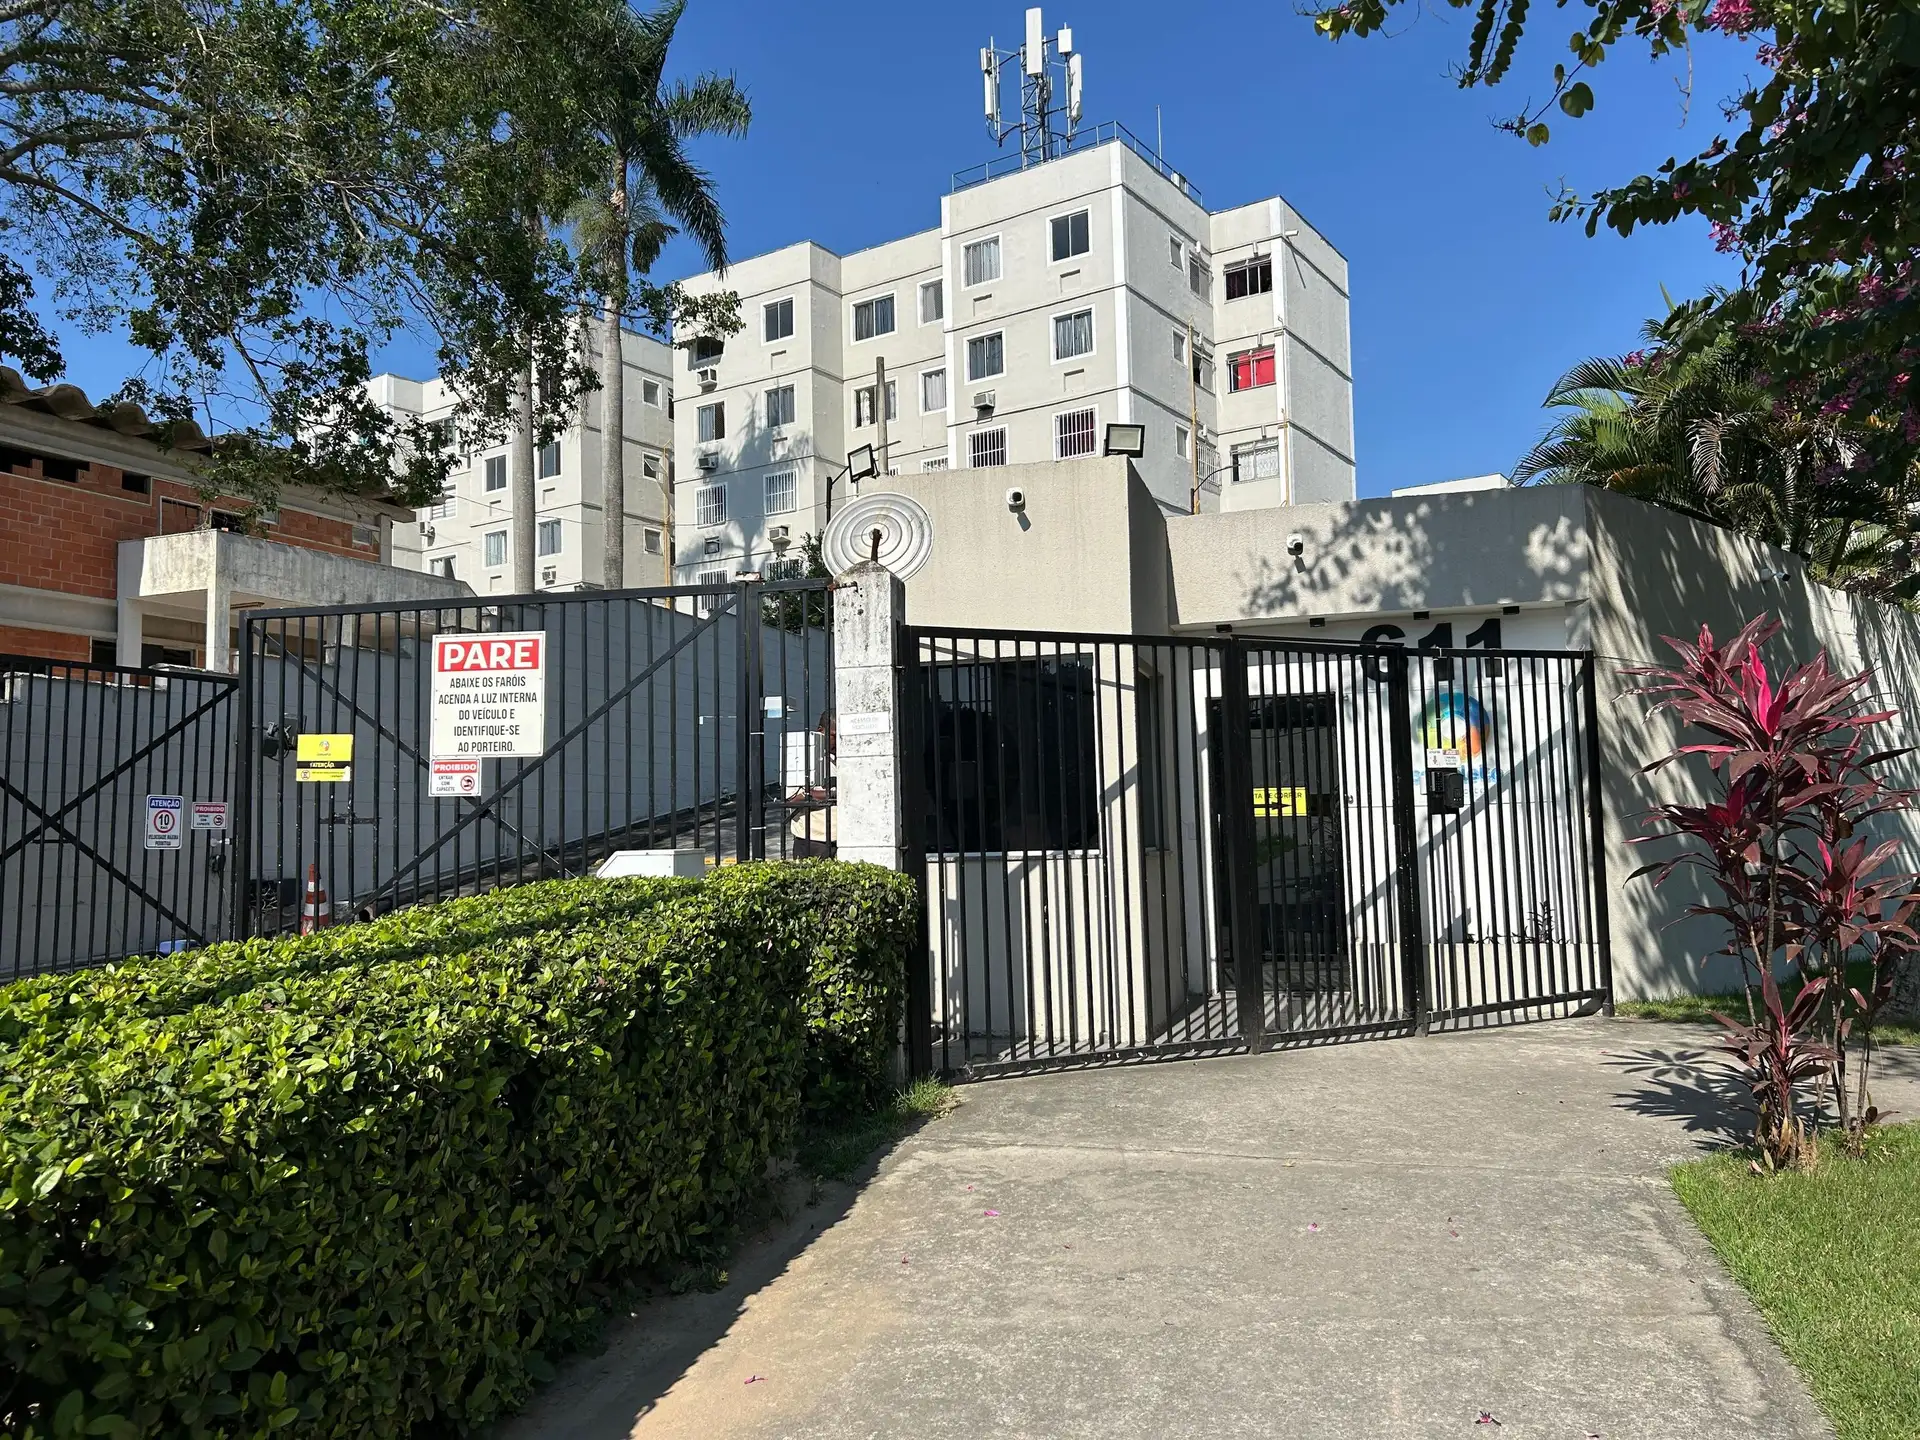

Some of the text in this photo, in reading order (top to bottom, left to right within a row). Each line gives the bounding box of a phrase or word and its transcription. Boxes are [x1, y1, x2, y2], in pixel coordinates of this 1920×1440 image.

[443, 641, 534, 671] PARE
[1361, 618, 1502, 683] 611
[450, 674, 526, 689] ABAIXE OS FARÓIS
[438, 691, 538, 705] ACENDA A LUZ INTERNA
[458, 707, 516, 721] DO VEÍCULO E
[453, 724, 521, 737] IDENTIFIQUE-SE
[457, 740, 516, 753] AO PORTEIRO.
[435, 763, 477, 771] PROIBIDO
[150, 799, 180, 808] ATENÇÃO
[158, 813, 170, 826] 10
